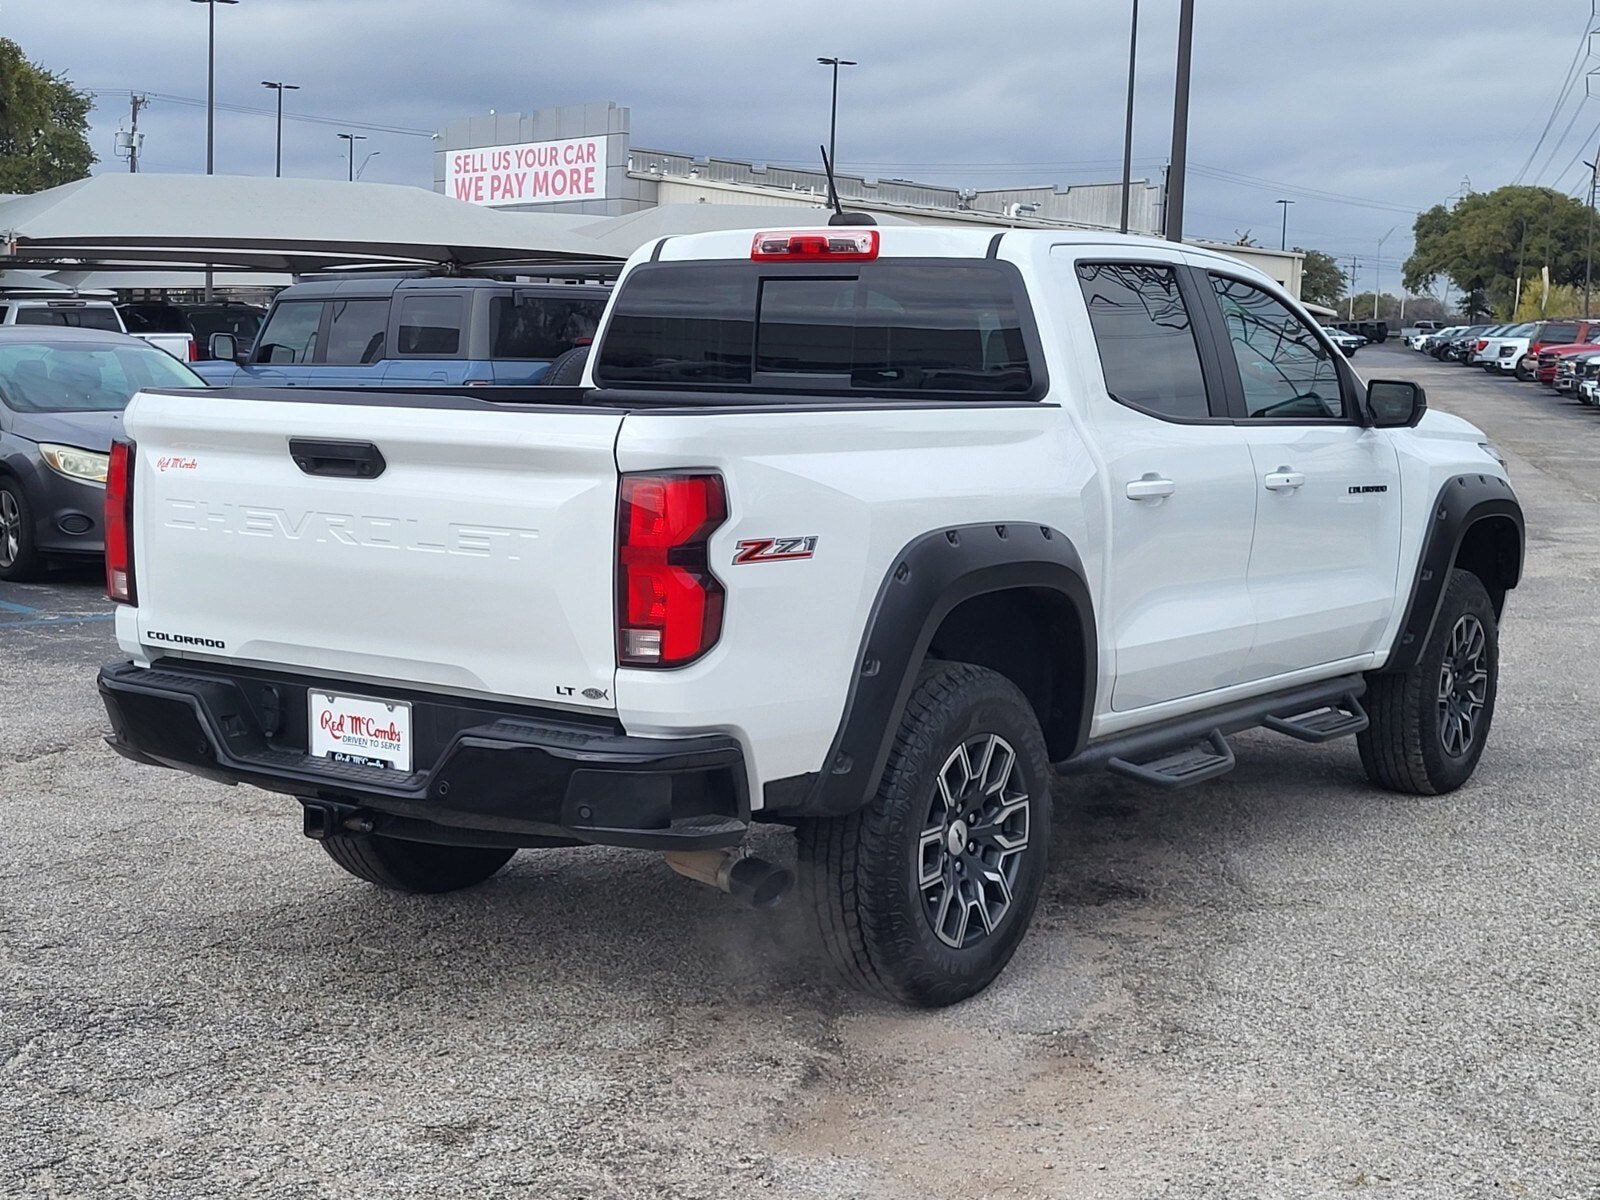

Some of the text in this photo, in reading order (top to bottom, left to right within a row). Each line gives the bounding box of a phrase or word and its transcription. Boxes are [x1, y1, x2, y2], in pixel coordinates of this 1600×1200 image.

[454, 143, 596, 174] SELL US YOUR CAR
[454, 167, 595, 201] WE PAY MORE
[1348, 485, 1387, 494] COLORADO
[164, 498, 540, 560] CHEVROLET
[731, 536, 818, 565] Z71
[147, 631, 225, 649] COLORADO
[556, 686, 576, 696] LT
[320, 710, 345, 740] Red
[342, 735, 401, 752] DRIVEN TO SERVE
